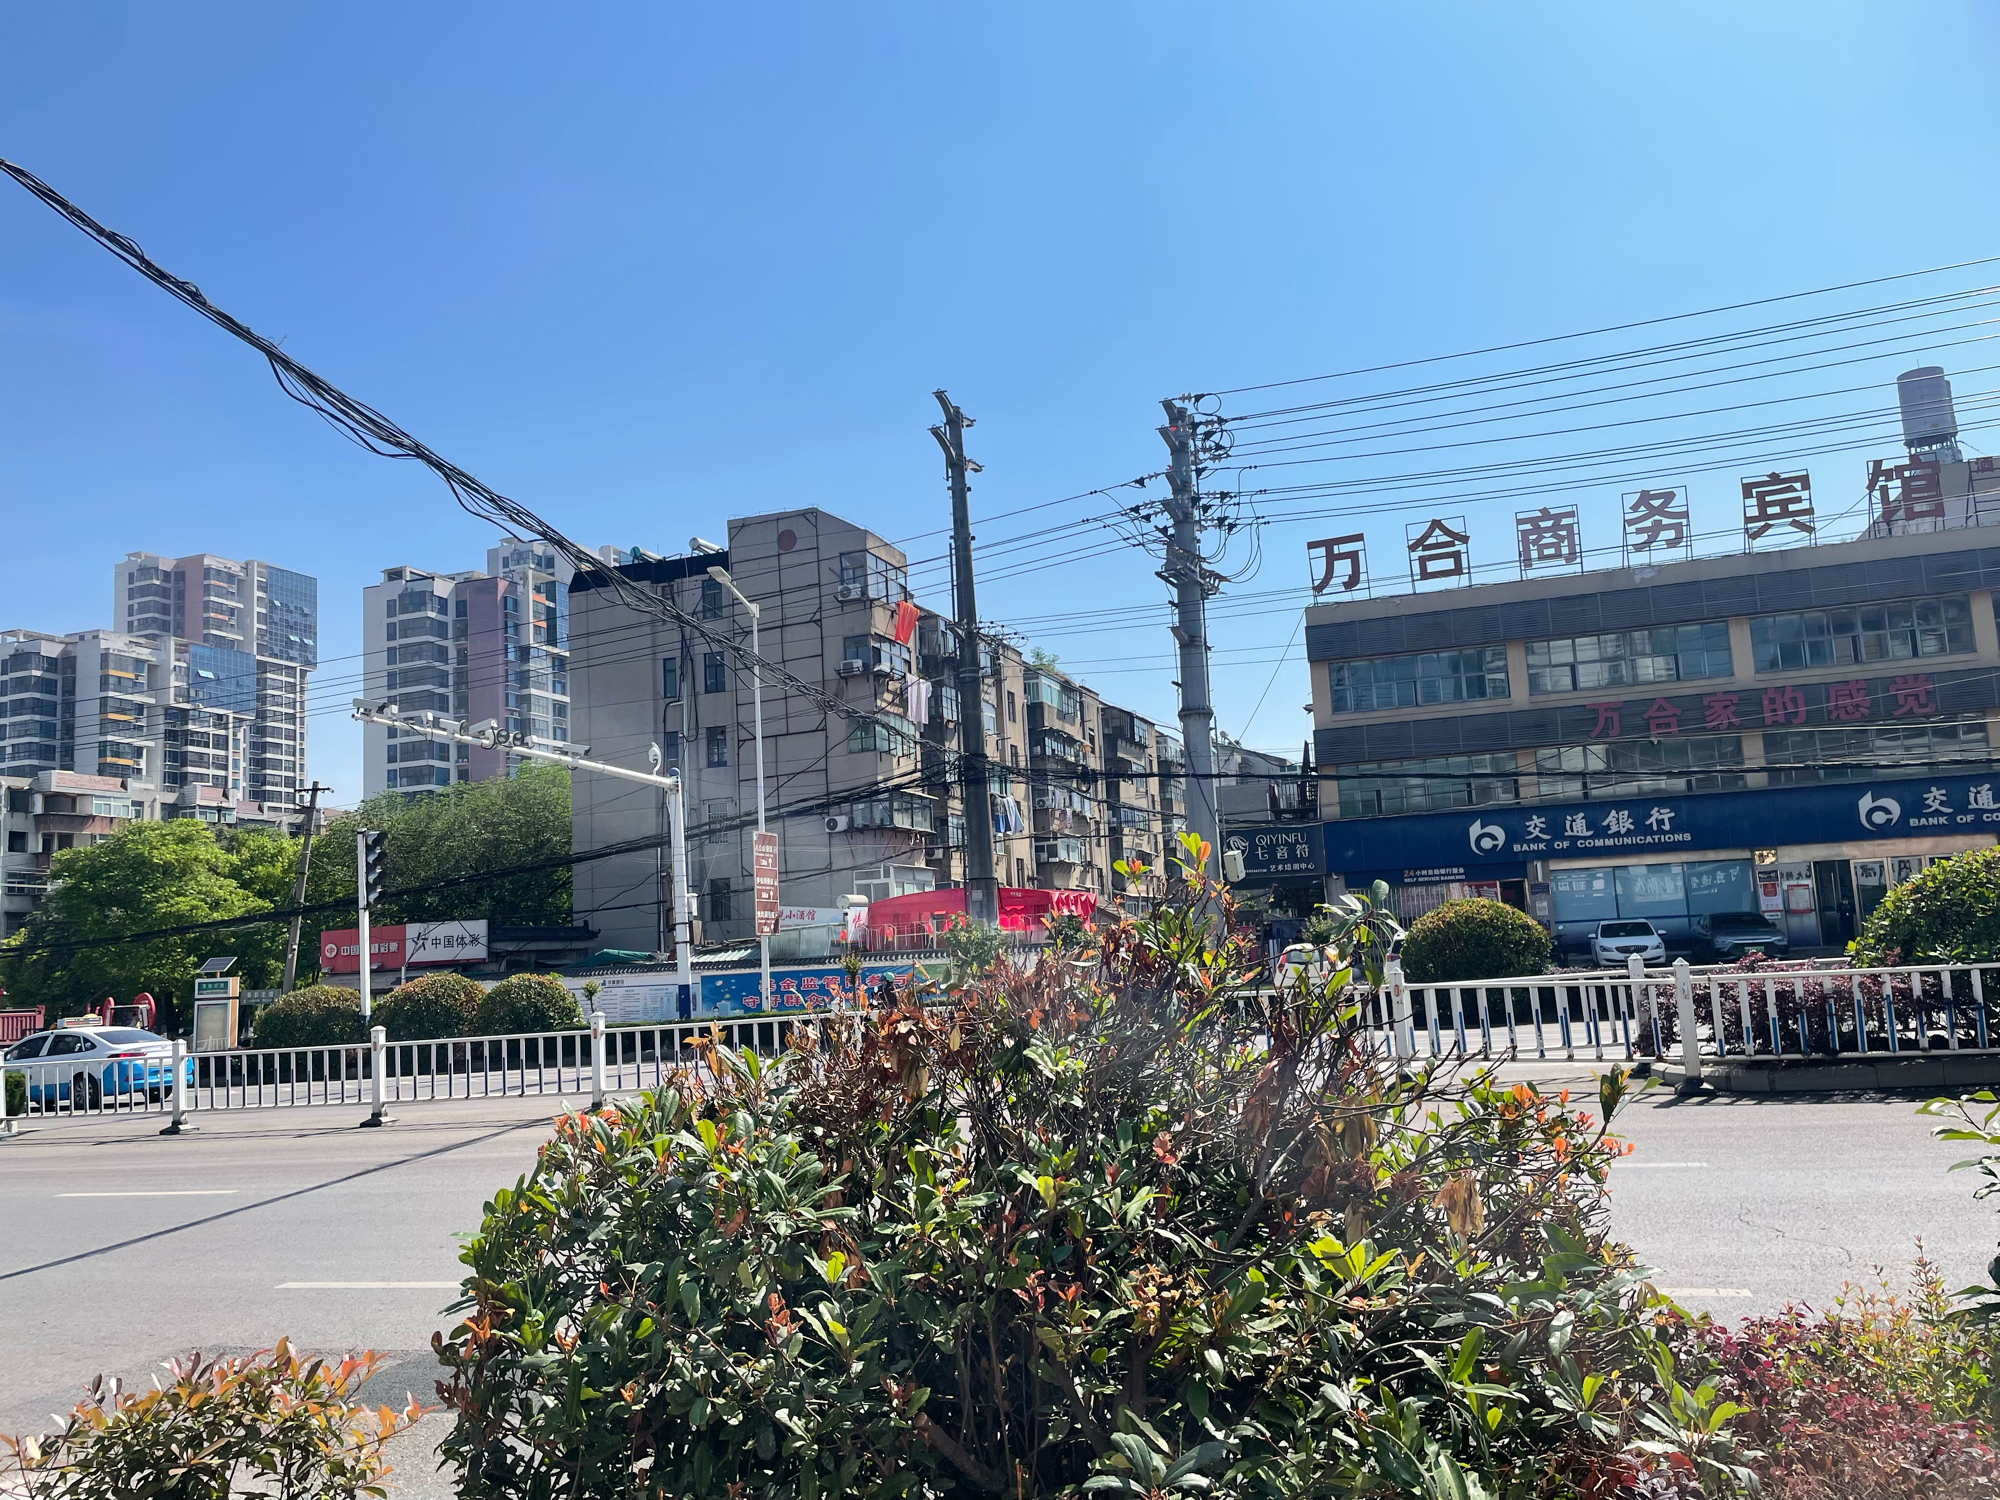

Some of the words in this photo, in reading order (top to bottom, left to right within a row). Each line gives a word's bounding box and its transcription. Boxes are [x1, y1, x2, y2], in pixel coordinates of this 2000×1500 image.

[1306, 453, 1946, 593] 万合商务宾馆
[1585, 674, 1938, 739] 万合家的感觉
[1923, 783, 2000, 814] 交通
[1909, 815, 1949, 827] BANK
[1956, 814, 1975, 824] OF
[1255, 832, 1307, 848] QIYINFU
[1513, 842, 1548, 853] BANK
[1554, 840, 1571, 850] OF
[1577, 832, 1692, 848] COMMUNICATIONS
[1255, 844, 1310, 861] 七音符
[340, 942, 399, 956] 中国利彩票
[431, 934, 481, 950] 中国体彩
